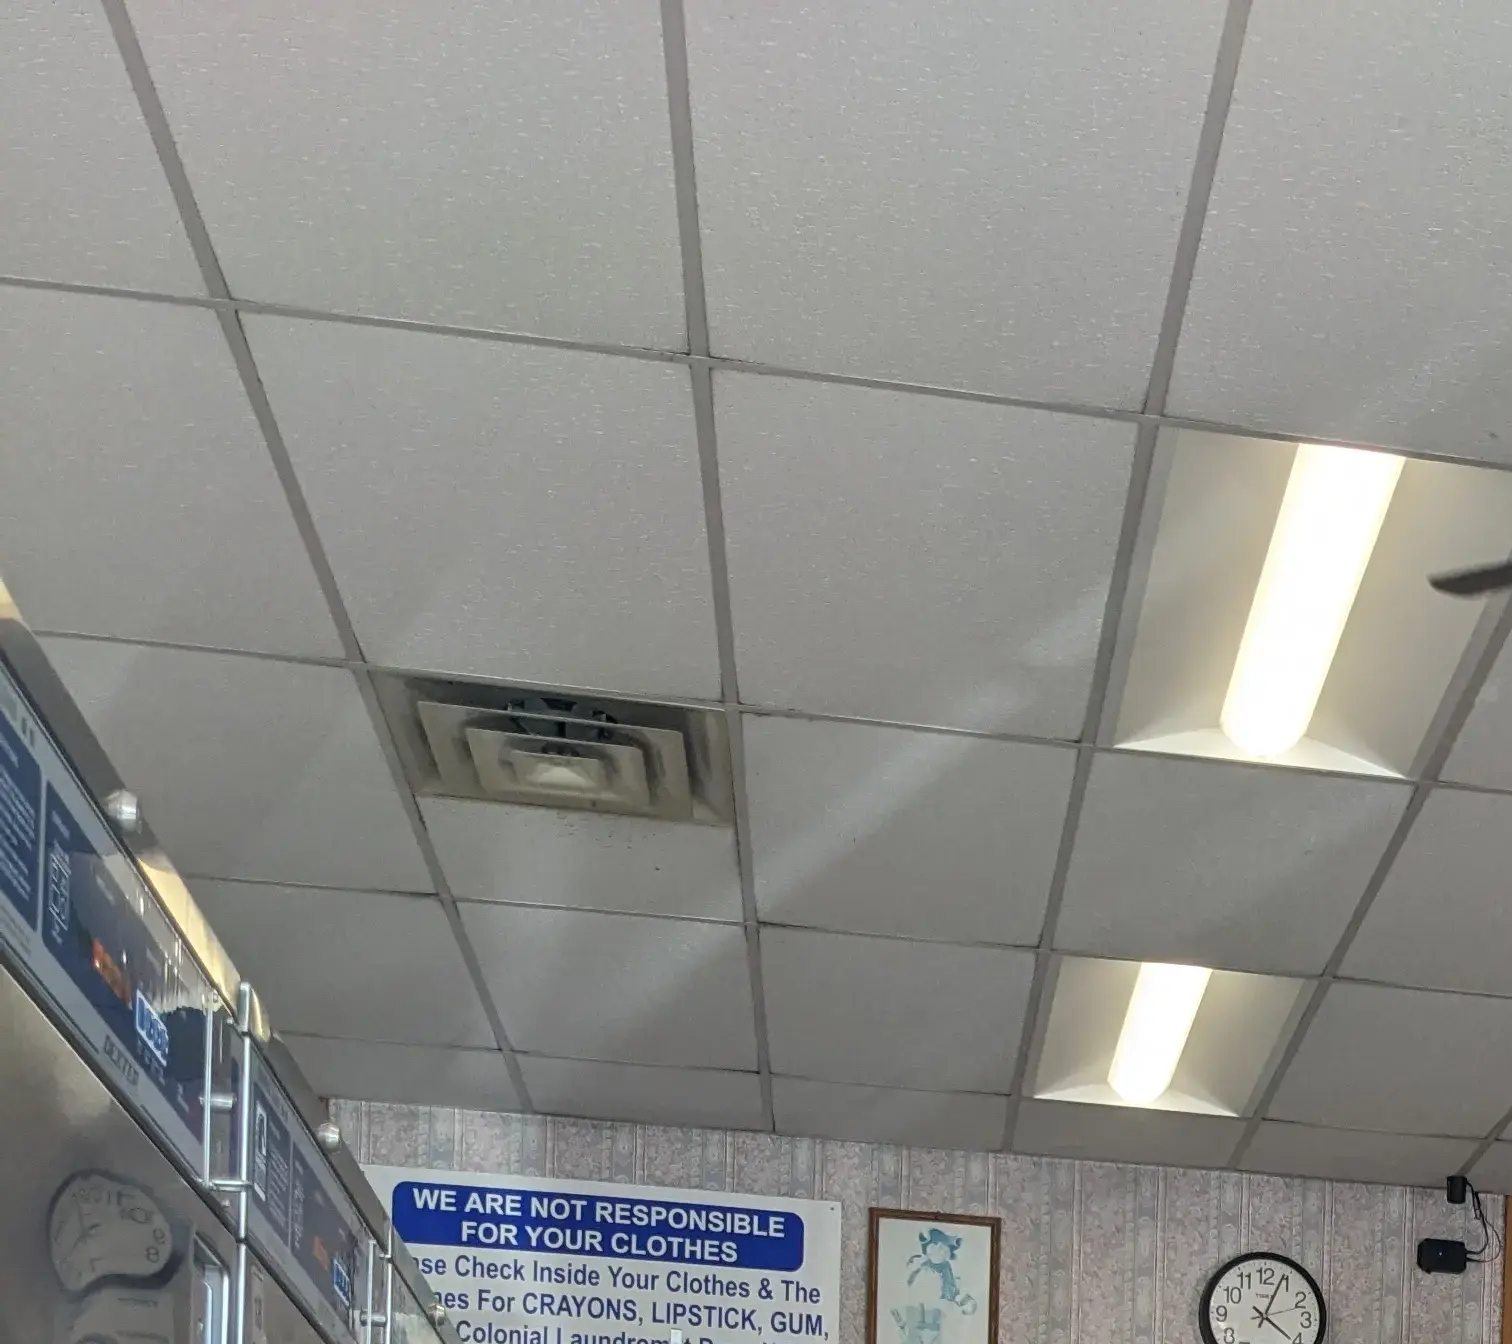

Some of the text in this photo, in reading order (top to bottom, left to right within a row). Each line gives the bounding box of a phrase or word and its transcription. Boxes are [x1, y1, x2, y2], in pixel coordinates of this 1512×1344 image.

[413, 1187, 785, 1238] WE ARE NOT RESPONSIBLE
[461, 1221, 738, 1263] FOR YOUR CLOTHES
[455, 1254, 525, 1281] Check
[533, 1260, 600, 1286] Inside
[607, 1266, 660, 1291] Your
[666, 1270, 751, 1298] Clothes
[758, 1278, 774, 1301] &
[781, 1279, 821, 1304] The
[1237, 1272, 1251, 1290] 11
[1256, 1267, 1275, 1286] 12
[1223, 1286, 1242, 1304] 10
[1294, 1291, 1307, 1309] 2
[477, 1289, 516, 1313] For
[522, 1292, 644, 1327] CRAYONS,
[651, 1301, 763, 1335] LIPSTICK,
[770, 1311, 829, 1341] GUM,
[1216, 1305, 1228, 1323] 9
[1300, 1311, 1312, 1329] 3
[1223, 1327, 1236, 1344] 8
